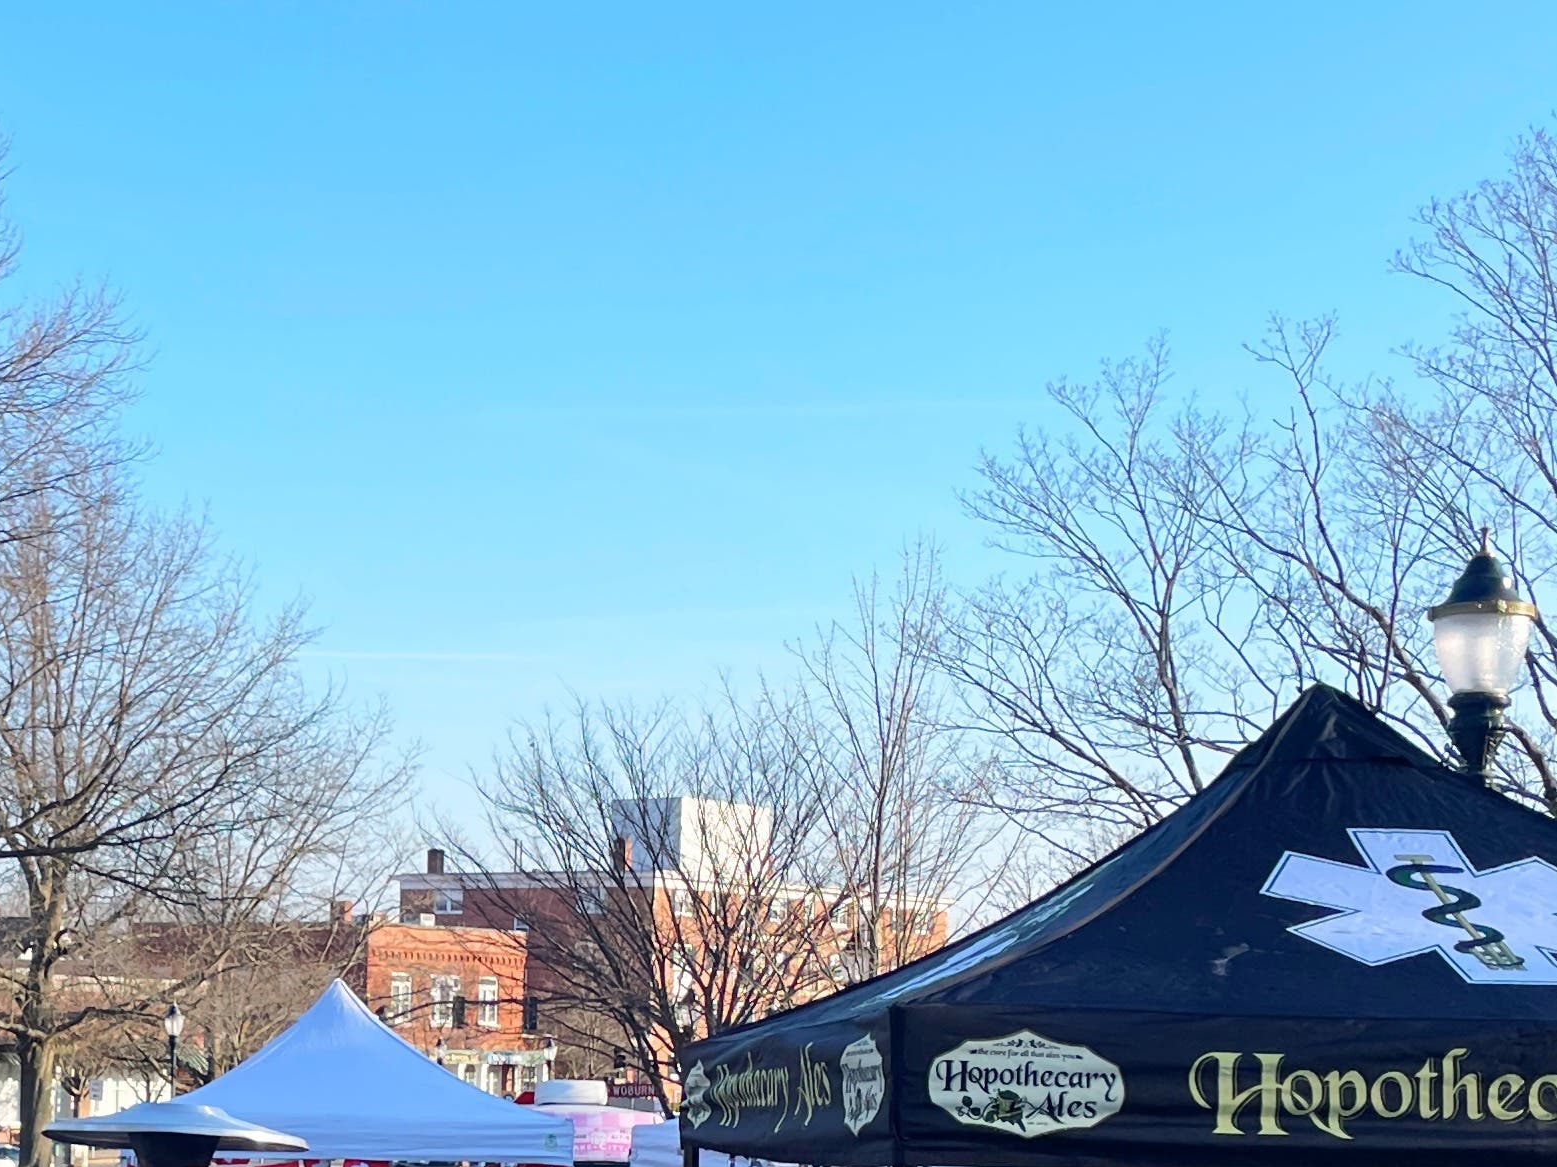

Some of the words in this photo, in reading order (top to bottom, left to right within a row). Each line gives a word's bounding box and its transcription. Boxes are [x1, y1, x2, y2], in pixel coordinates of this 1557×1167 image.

[612, 1085, 654, 1097] WOBURN
[794, 1042, 832, 1127] Ales
[936, 1060, 1117, 1102] Hopothecary
[1024, 1091, 1098, 1125] Ales
